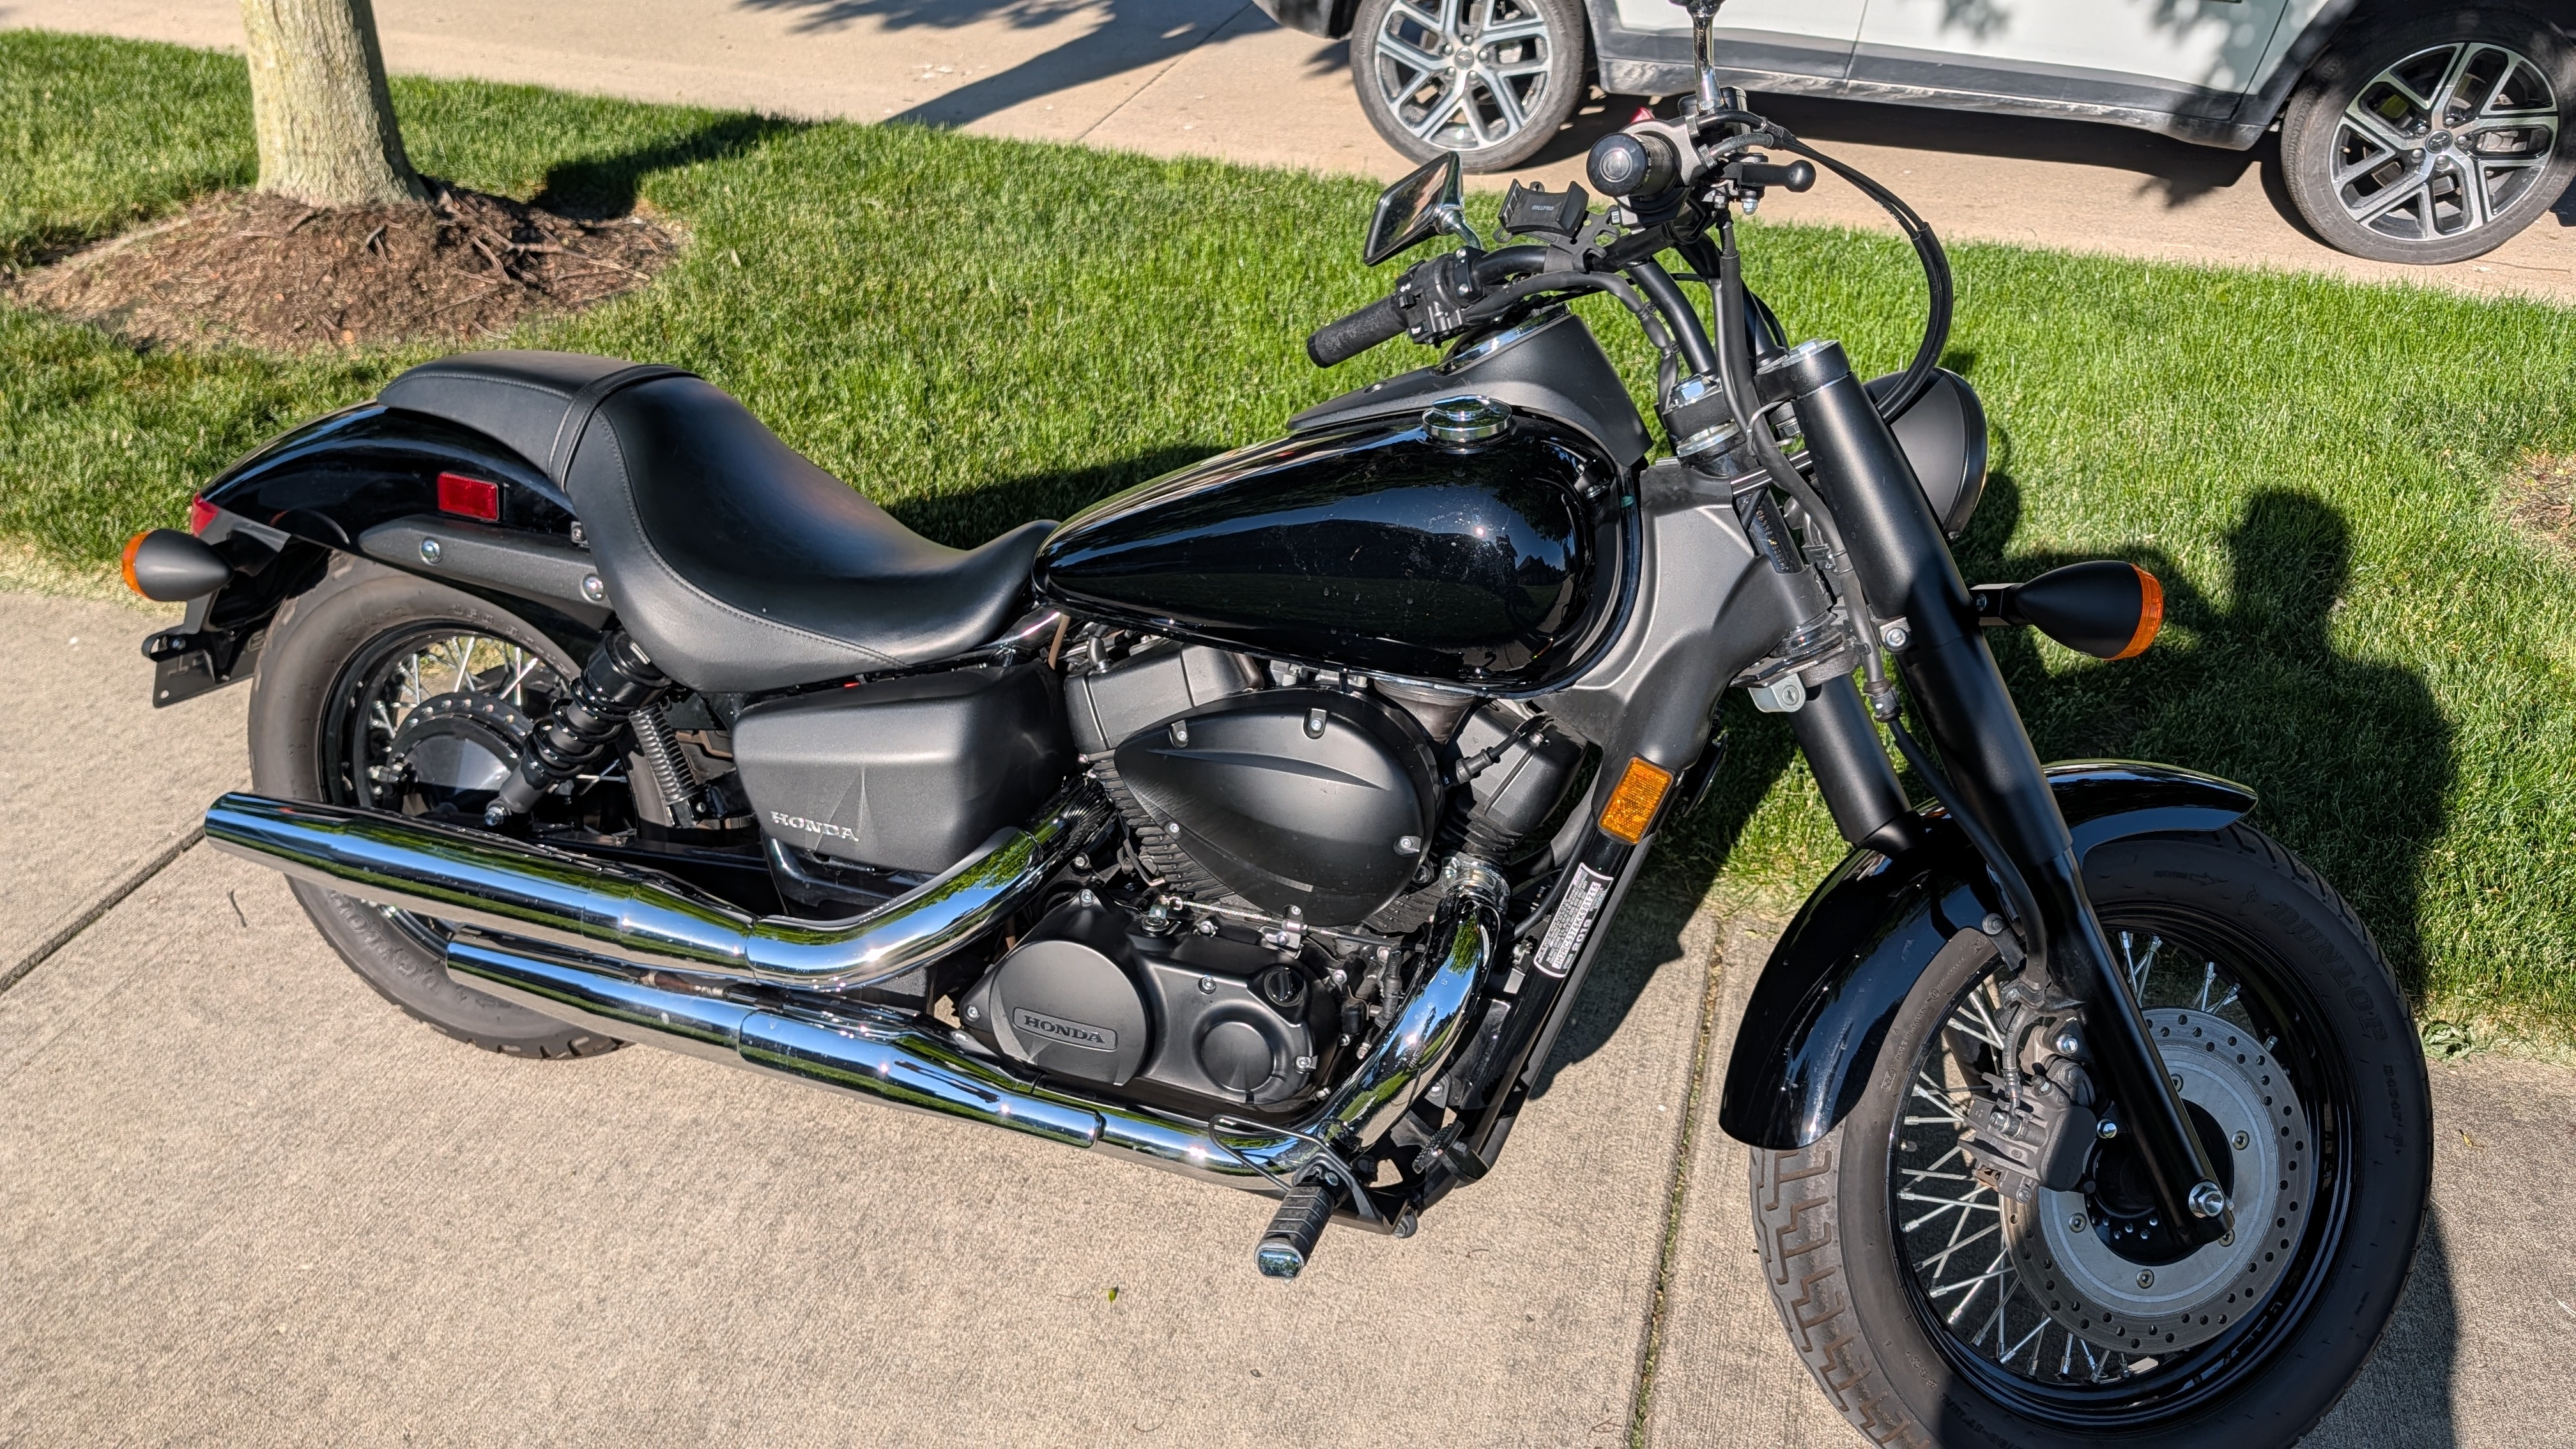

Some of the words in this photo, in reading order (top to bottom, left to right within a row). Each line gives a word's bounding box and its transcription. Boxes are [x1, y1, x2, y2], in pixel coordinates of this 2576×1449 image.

[770, 811, 859, 842] HONDA
[328, 892, 449, 995] DUNLOP
[1572, 919, 1591, 951] 2019
[2265, 901, 2389, 1042] DUNLOP
[1024, 1015, 1105, 1044] HONDA
[1895, 1039, 1908, 1061] MADE
[1912, 1006, 1927, 1031] JAPAN
